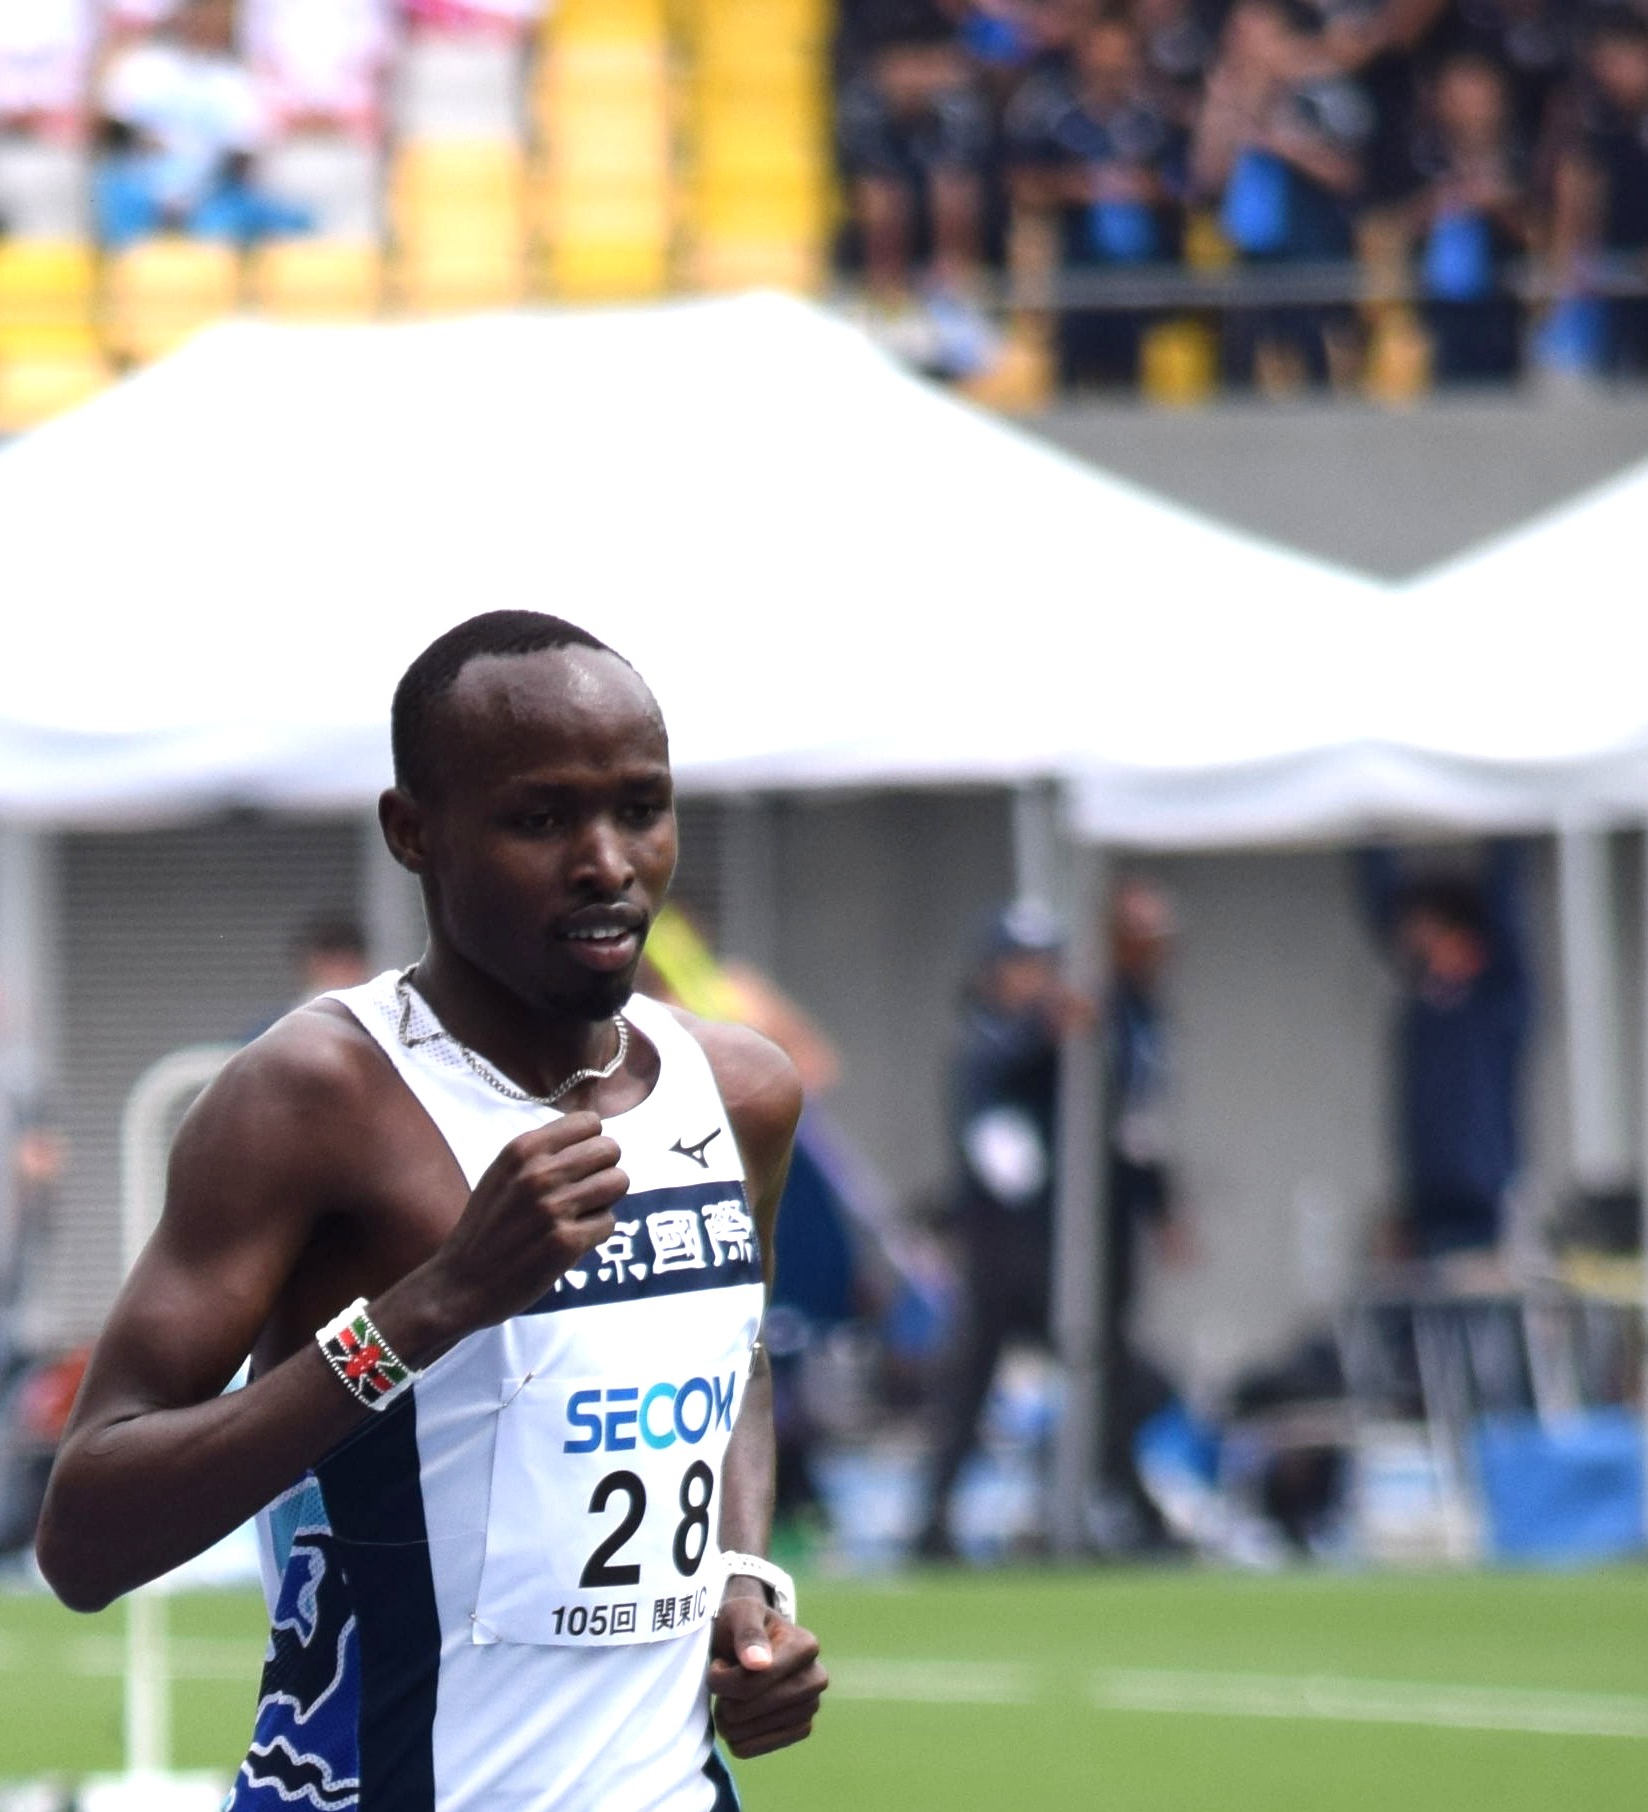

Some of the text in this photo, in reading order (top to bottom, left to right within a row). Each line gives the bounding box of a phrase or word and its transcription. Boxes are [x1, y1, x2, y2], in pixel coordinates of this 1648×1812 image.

[554, 1200, 753, 1292] 京國際
[563, 1371, 736, 1454] SECOM
[578, 1459, 714, 1589] 28
[551, 1586, 708, 1636] 105回 関東IC
